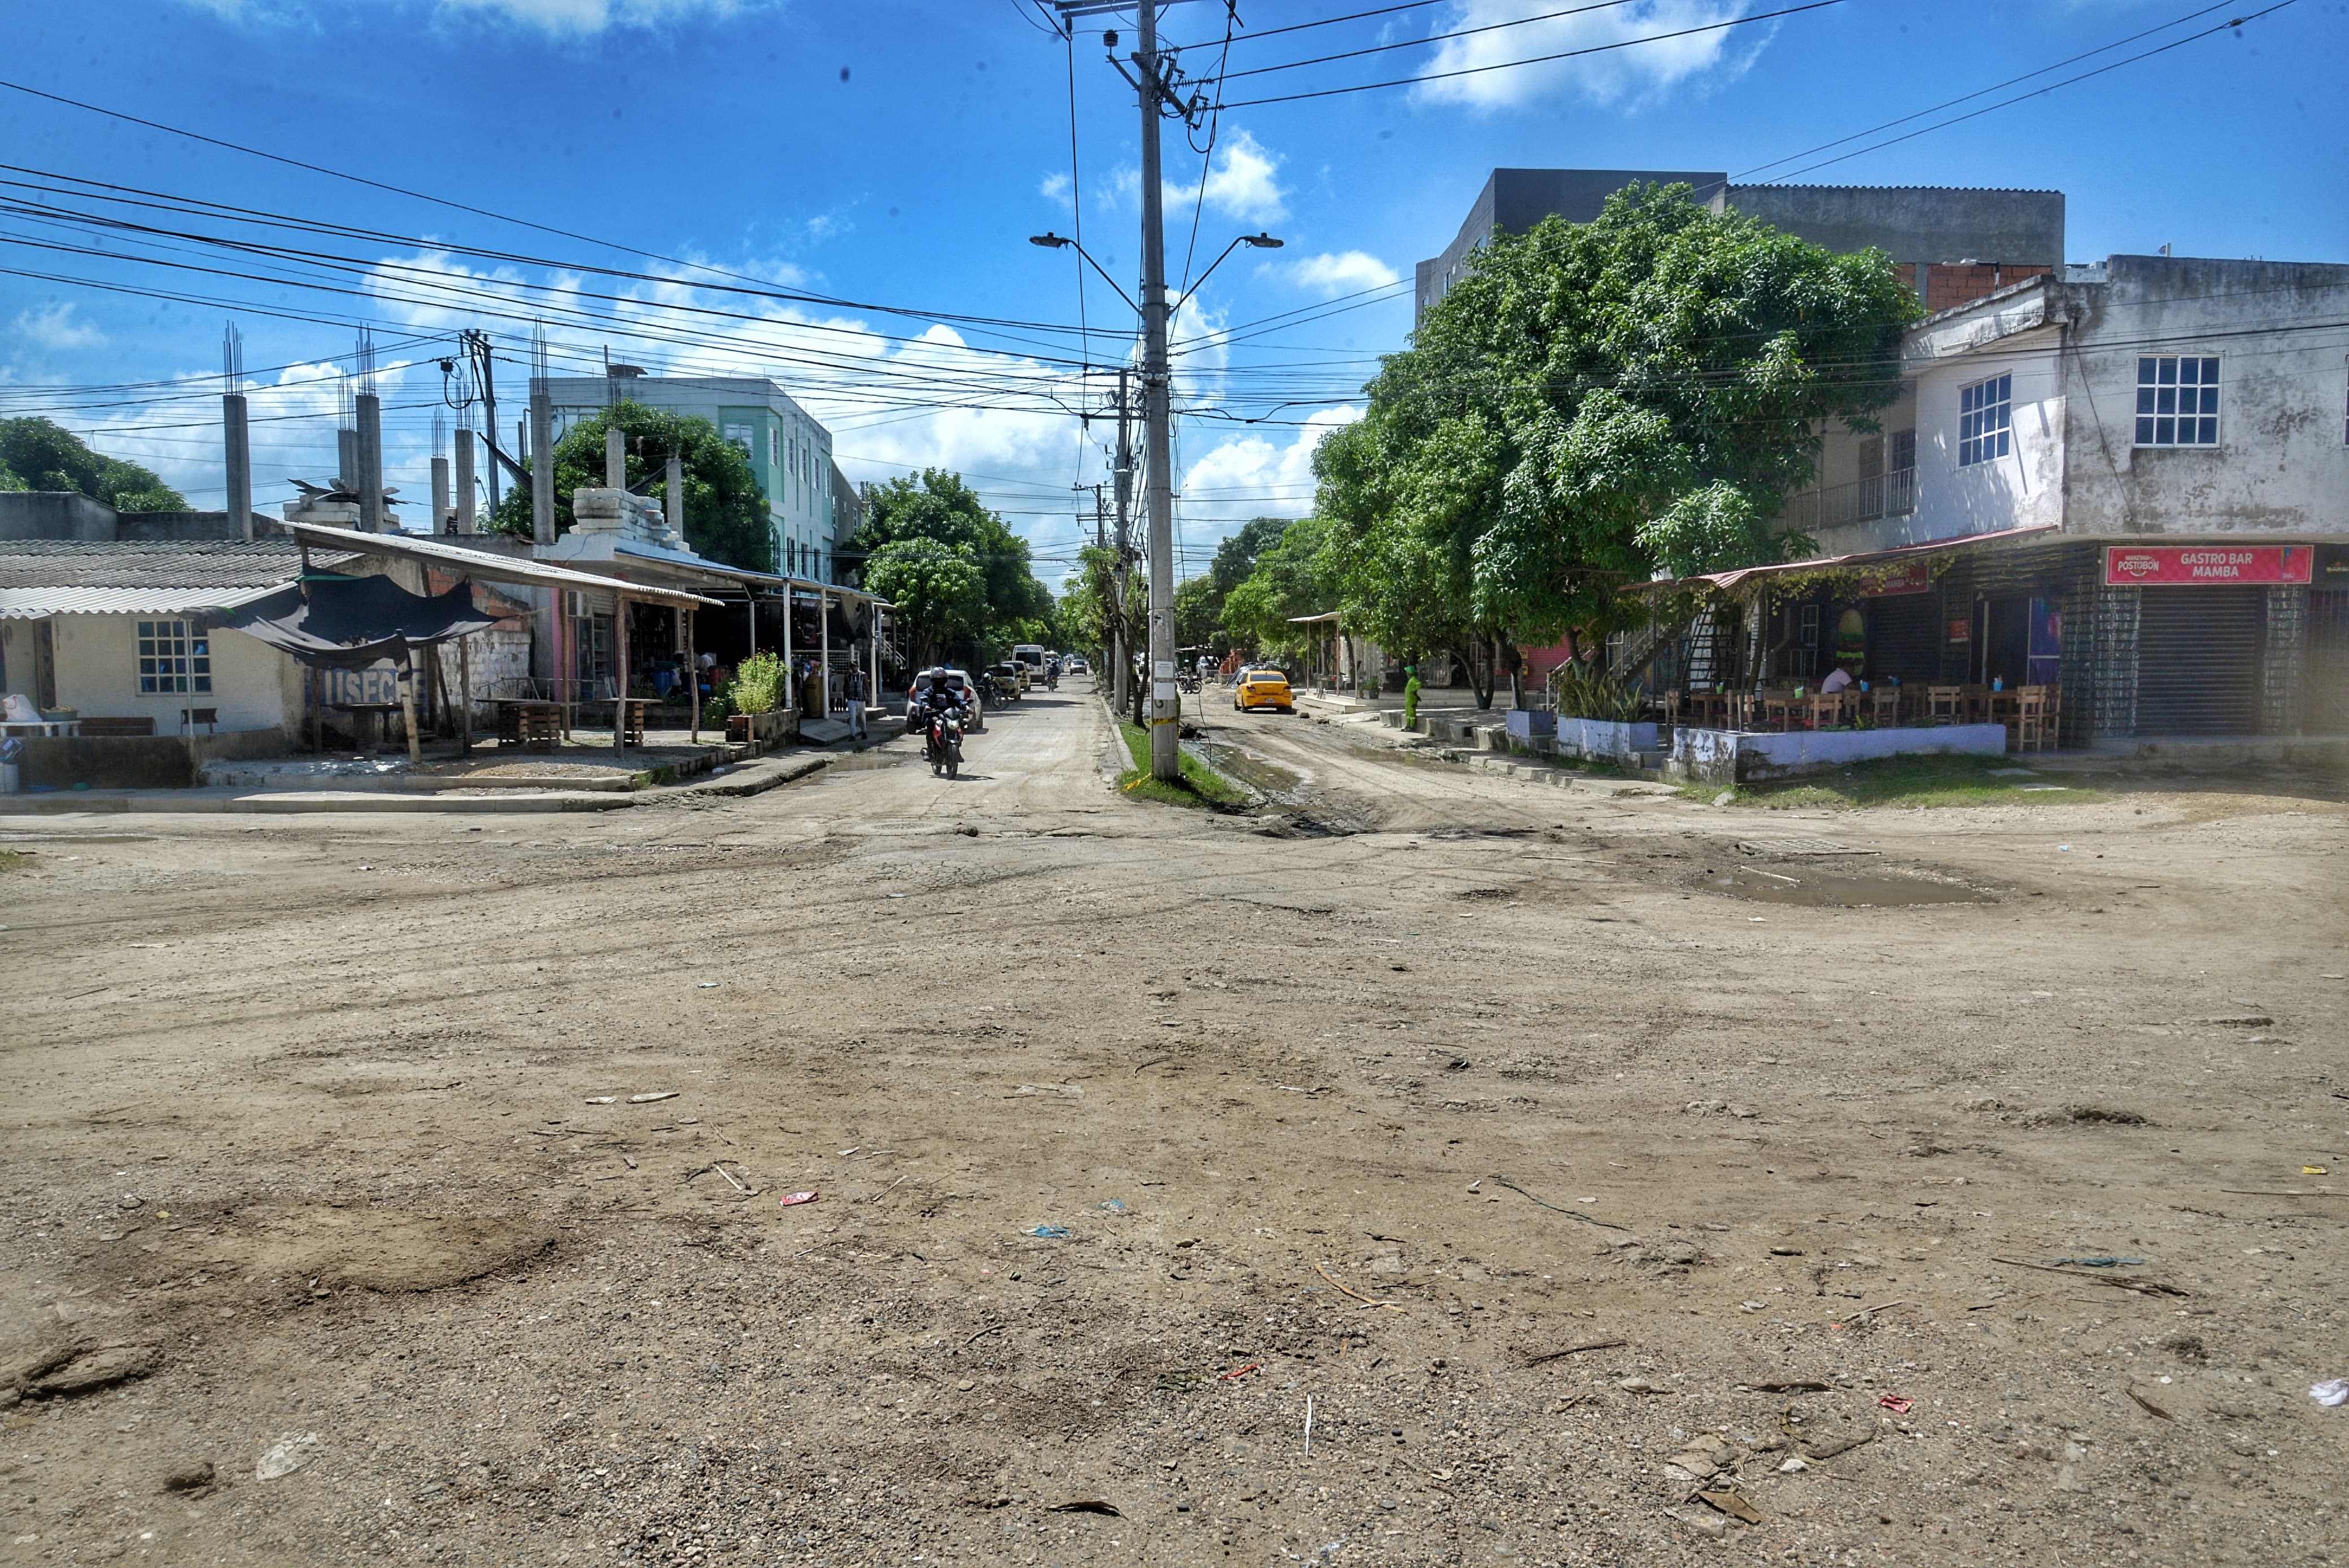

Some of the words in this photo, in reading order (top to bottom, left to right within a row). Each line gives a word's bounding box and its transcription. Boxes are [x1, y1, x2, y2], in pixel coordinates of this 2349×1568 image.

[2181, 553, 2226, 564] GASTRO
[2229, 553, 2252, 564] BAR
[2193, 566, 2239, 577] MAMBA
